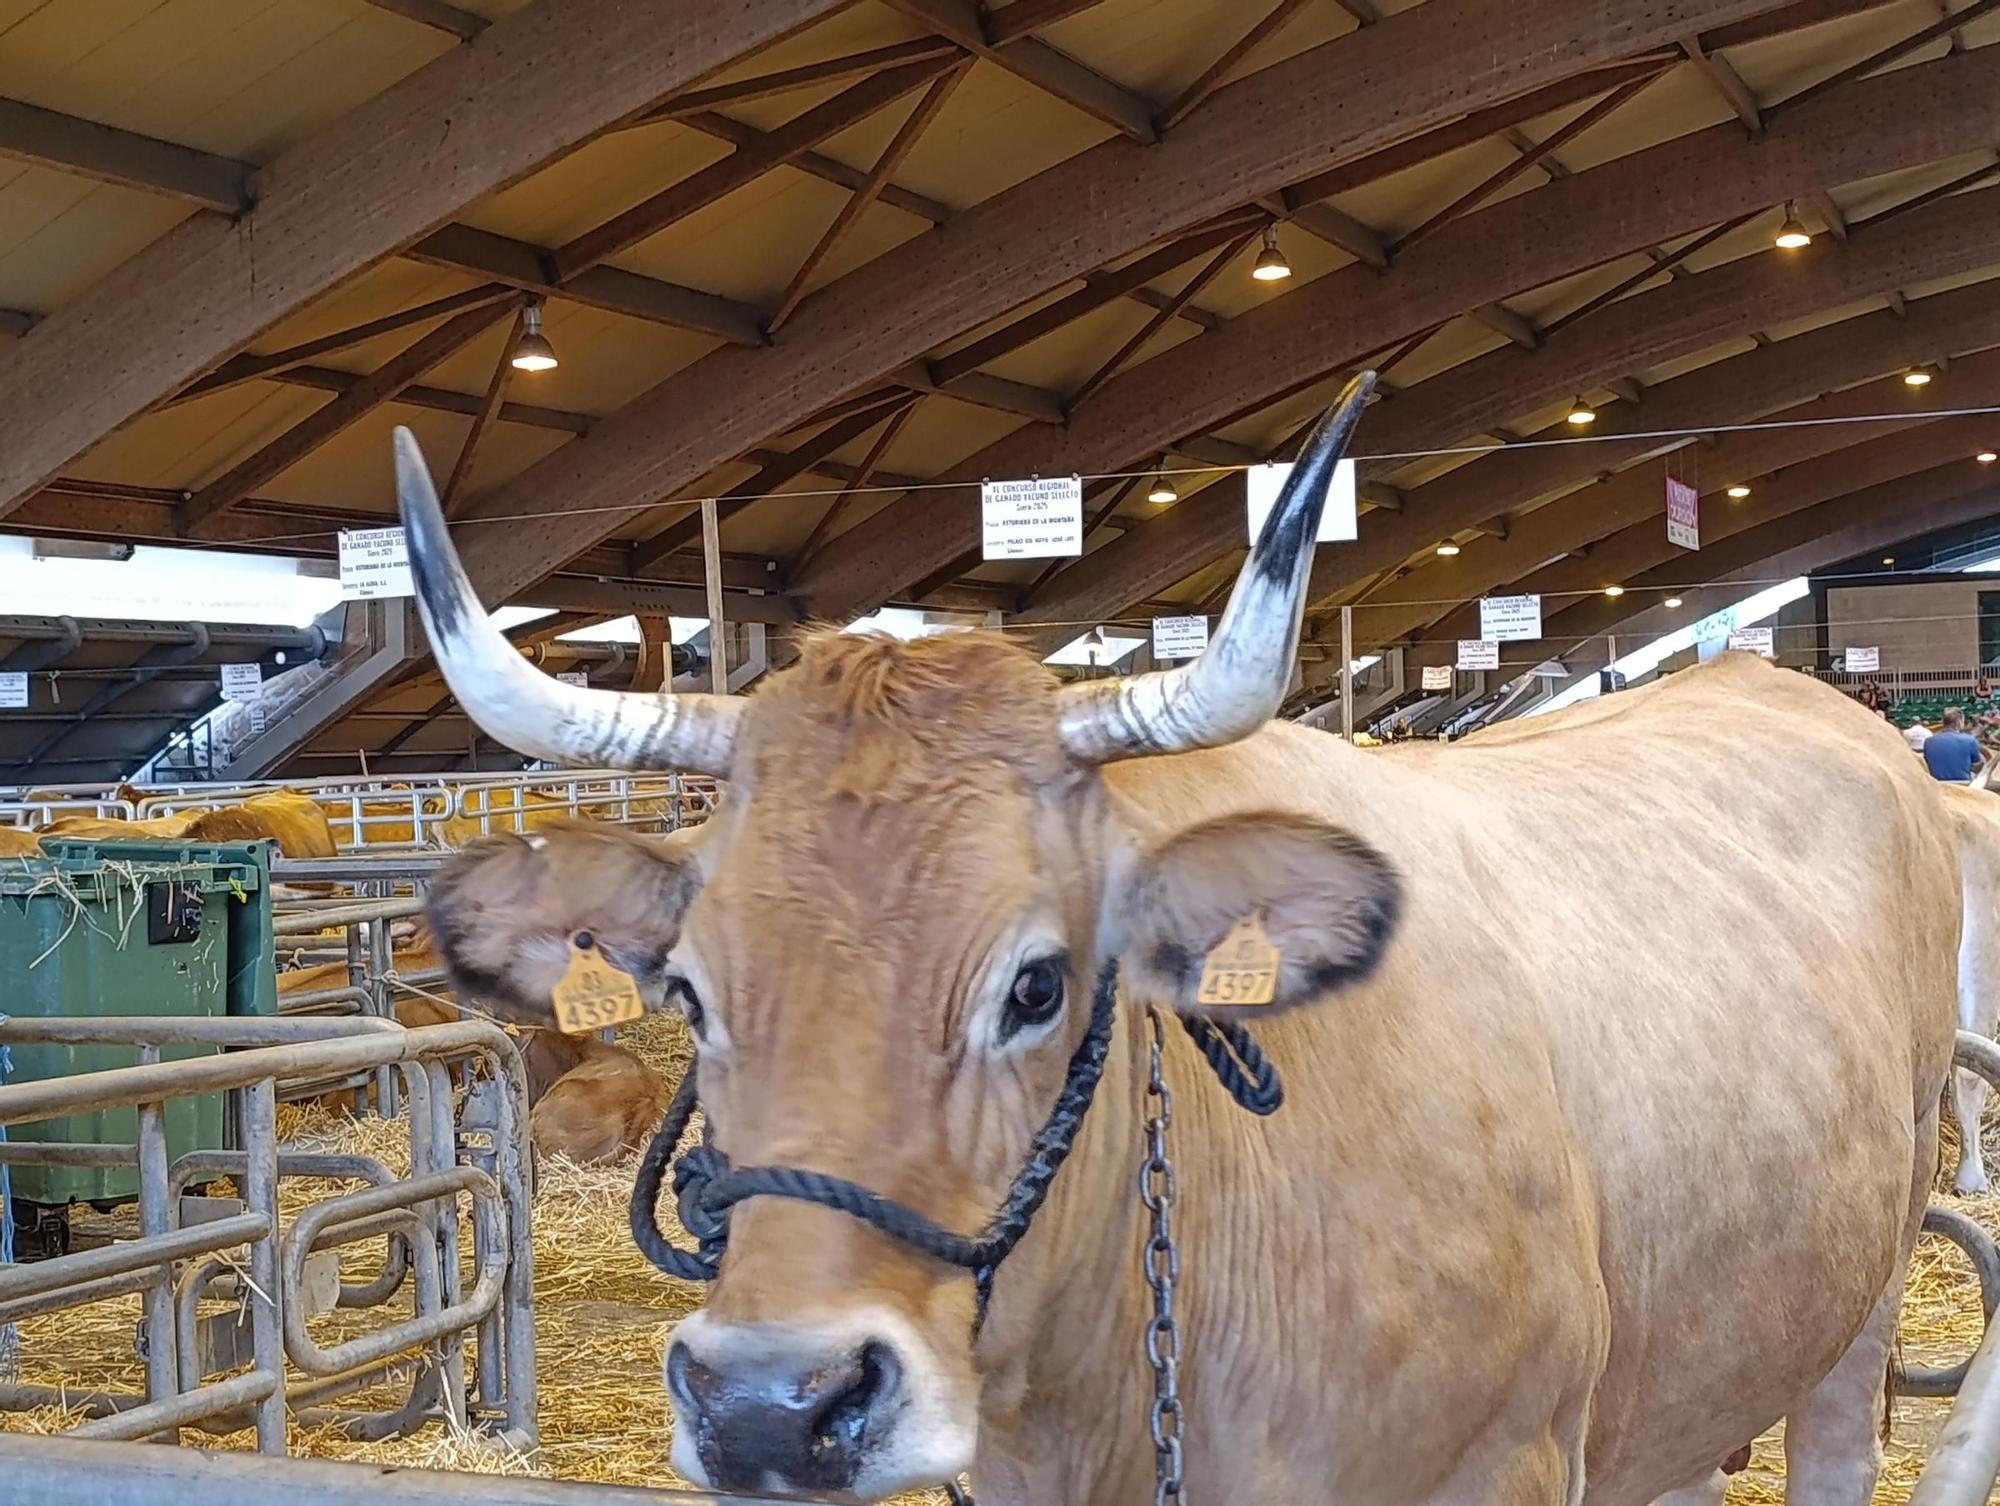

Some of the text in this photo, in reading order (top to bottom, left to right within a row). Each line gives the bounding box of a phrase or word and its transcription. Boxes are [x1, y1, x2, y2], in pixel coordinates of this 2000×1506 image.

[986, 491, 1079, 503] DE GANADO VACUNO SELECTO
[1002, 483, 1037, 493] CONCURSO
[1040, 482, 1070, 490] REGIONAL
[1203, 971, 1272, 1001] 4397
[565, 992, 634, 1027] 4397
